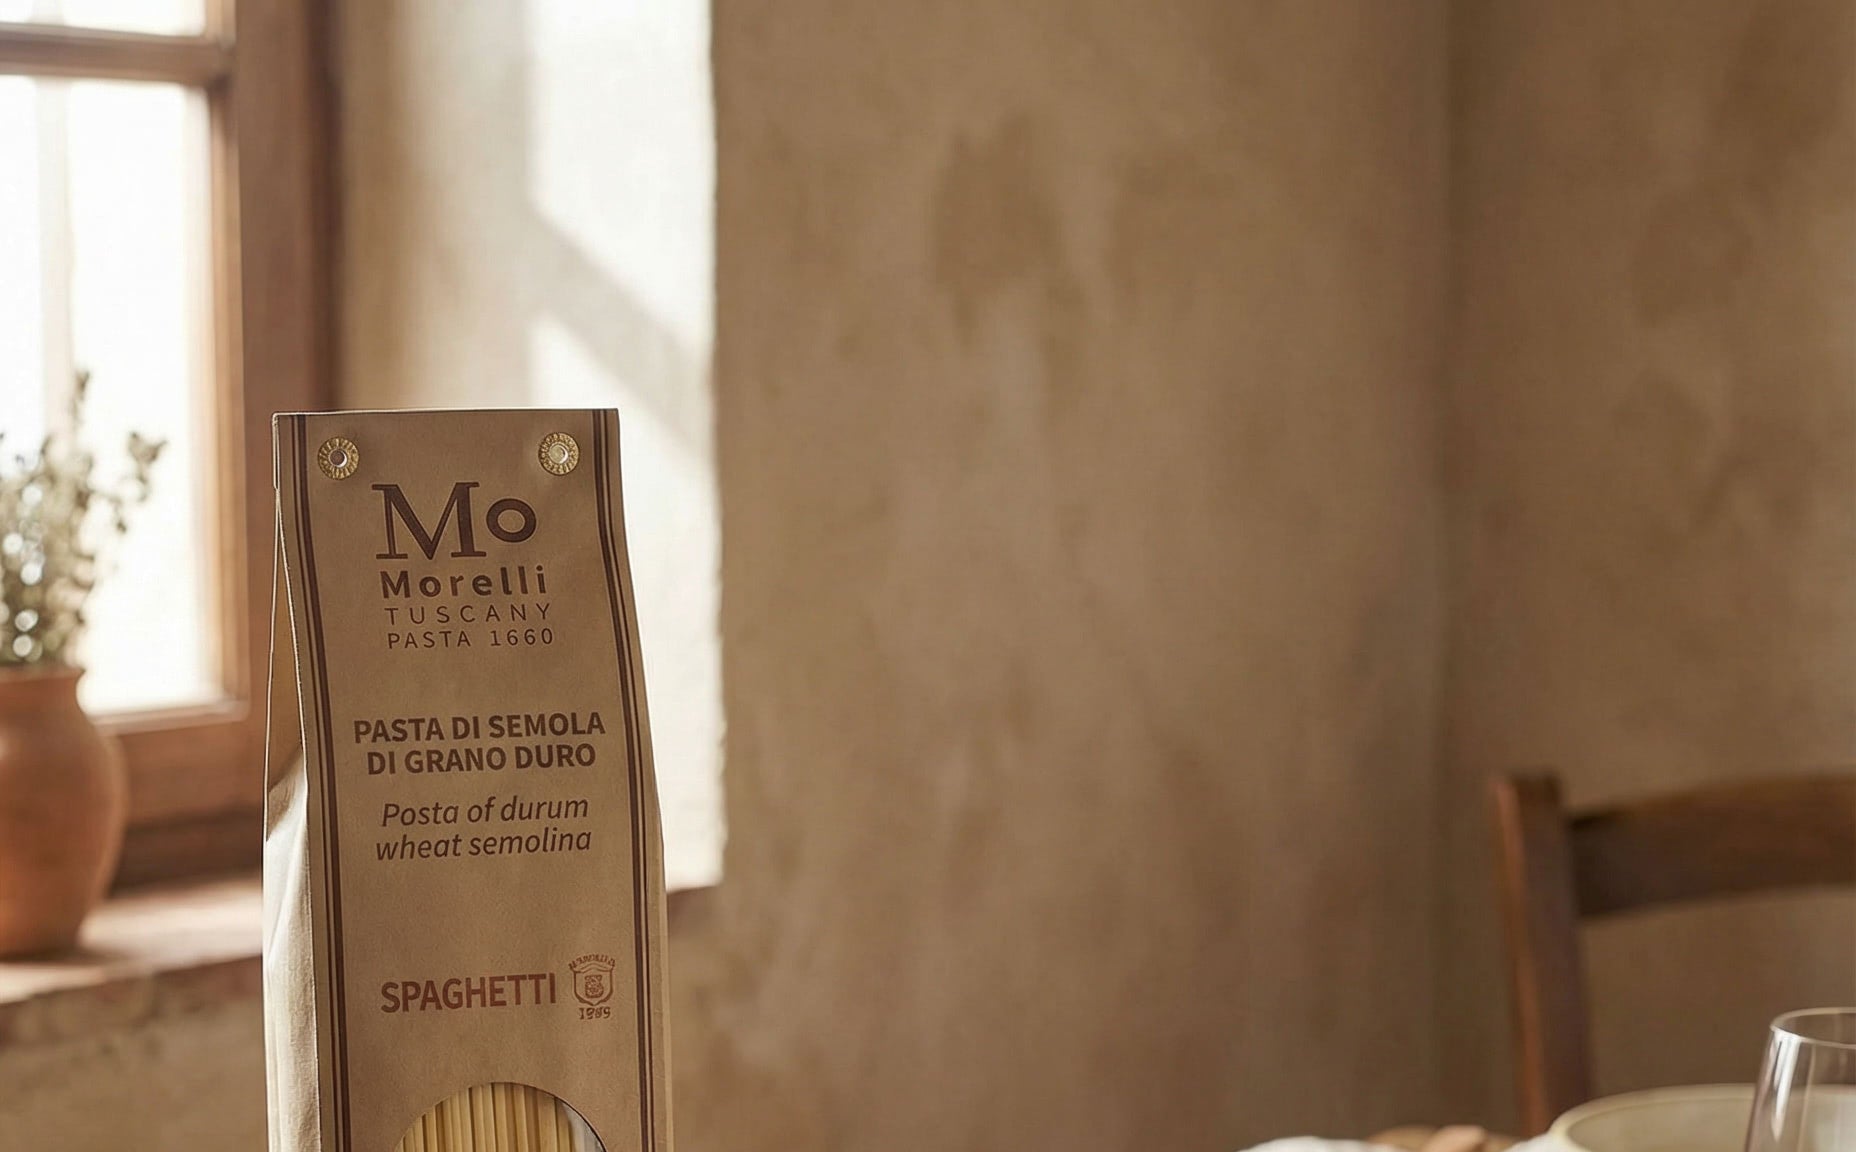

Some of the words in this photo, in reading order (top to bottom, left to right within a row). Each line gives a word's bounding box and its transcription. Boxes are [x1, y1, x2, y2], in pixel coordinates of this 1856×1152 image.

[372, 482, 537, 560] Mo
[380, 565, 547, 599] Morelli
[385, 603, 550, 626] TUSCANY
[388, 630, 471, 649] PASTA
[490, 628, 553, 646] 1660
[354, 717, 445, 744] PASTA
[452, 716, 481, 740] DI
[488, 712, 606, 739] SEMOLA
[367, 751, 397, 775] DI
[404, 747, 507, 773] GRANO
[514, 743, 596, 769] DURO
[467, 796, 496, 823] of
[500, 795, 589, 821] durum
[376, 834, 462, 860] wheat
[468, 827, 592, 856] semolina
[381, 972, 556, 1014] SPAGHETTI
